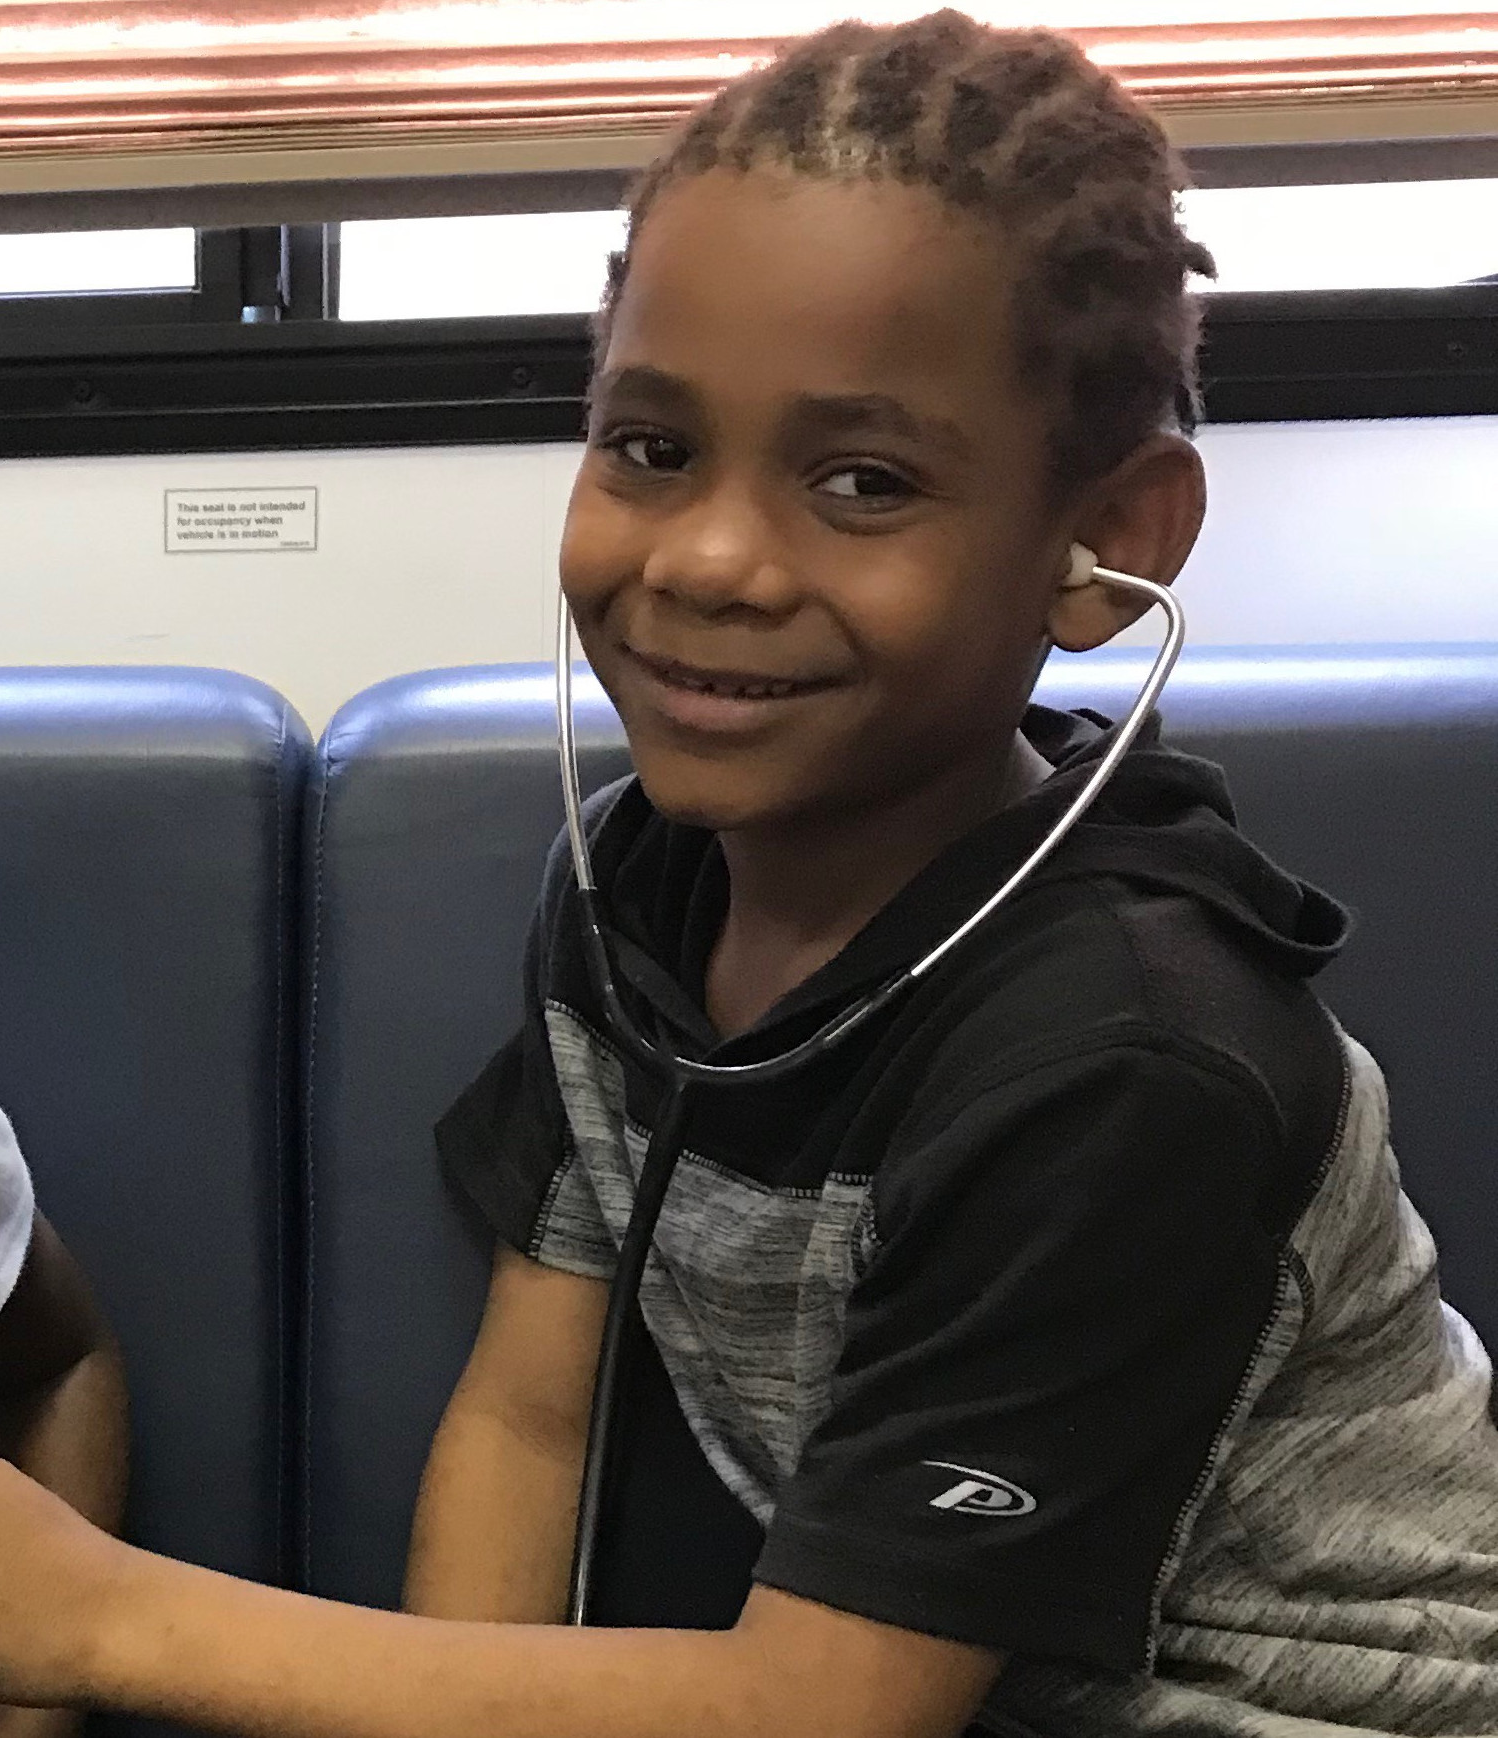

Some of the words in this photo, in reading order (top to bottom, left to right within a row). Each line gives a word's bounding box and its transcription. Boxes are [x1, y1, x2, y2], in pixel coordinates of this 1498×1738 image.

[177, 502, 199, 512] This
[203, 502, 225, 512] seat
[227, 502, 237, 511] is
[239, 502, 257, 511] not
[259, 501, 306, 511] intended
[177, 516, 191, 526] for
[194, 517, 251, 527] occupancy
[254, 516, 283, 525] when
[177, 530, 214, 540] vehicle
[217, 530, 227, 540] is
[229, 530, 239, 539] in
[241, 529, 279, 538] motion
